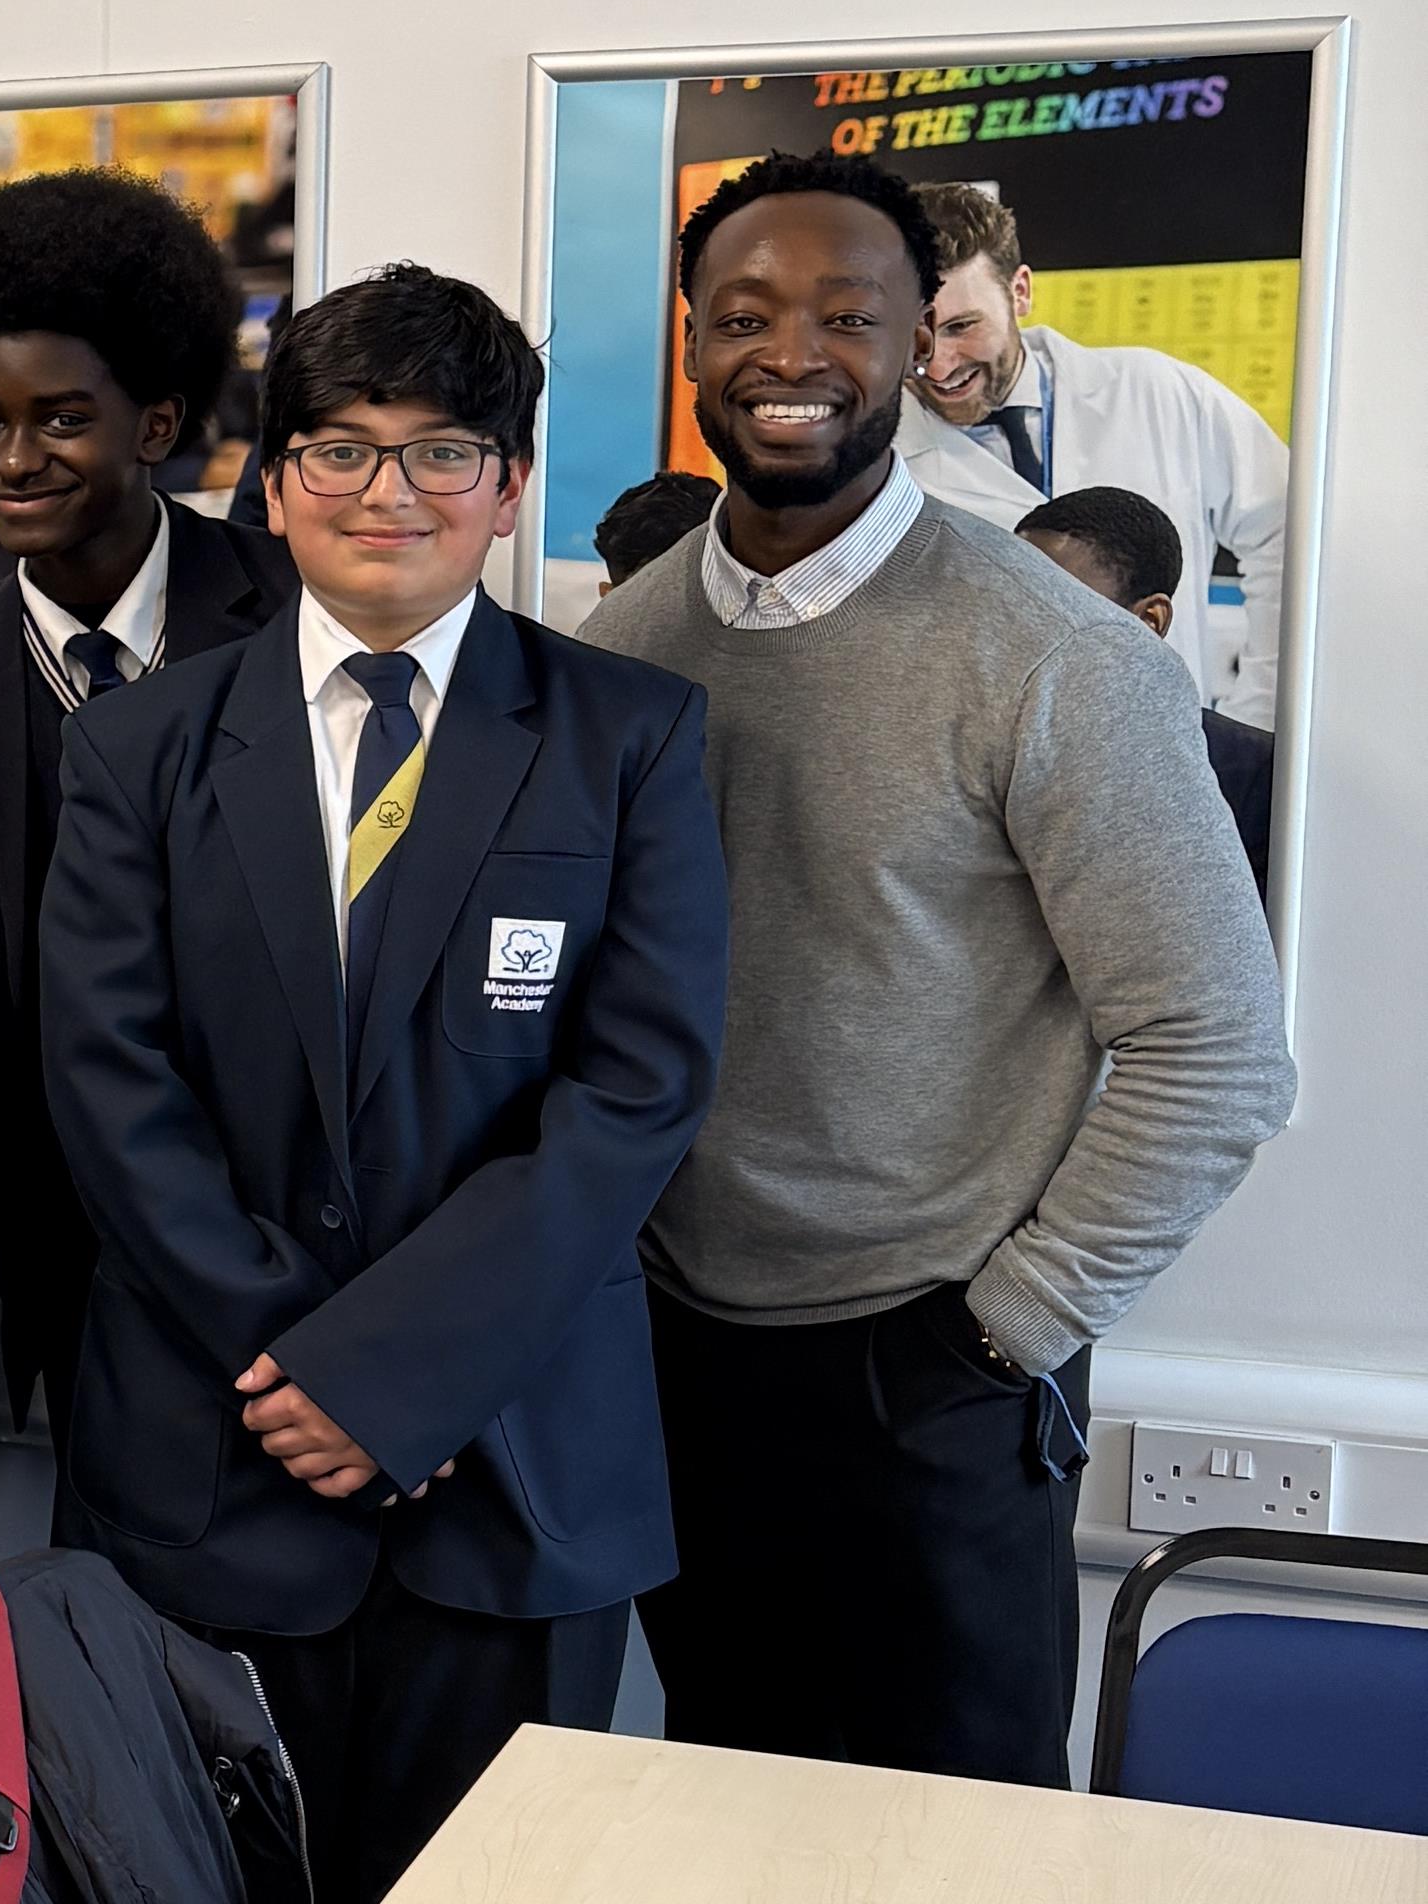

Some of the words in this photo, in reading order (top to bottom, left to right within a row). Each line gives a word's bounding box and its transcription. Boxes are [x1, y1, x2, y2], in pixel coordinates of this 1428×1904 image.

[814, 71, 890, 108] THE
[831, 116, 888, 156] OF
[891, 103, 977, 150] THE
[974, 75, 1231, 141] ELEMENTS
[483, 980, 555, 997] Manchester
[491, 996, 546, 1013] Academy
